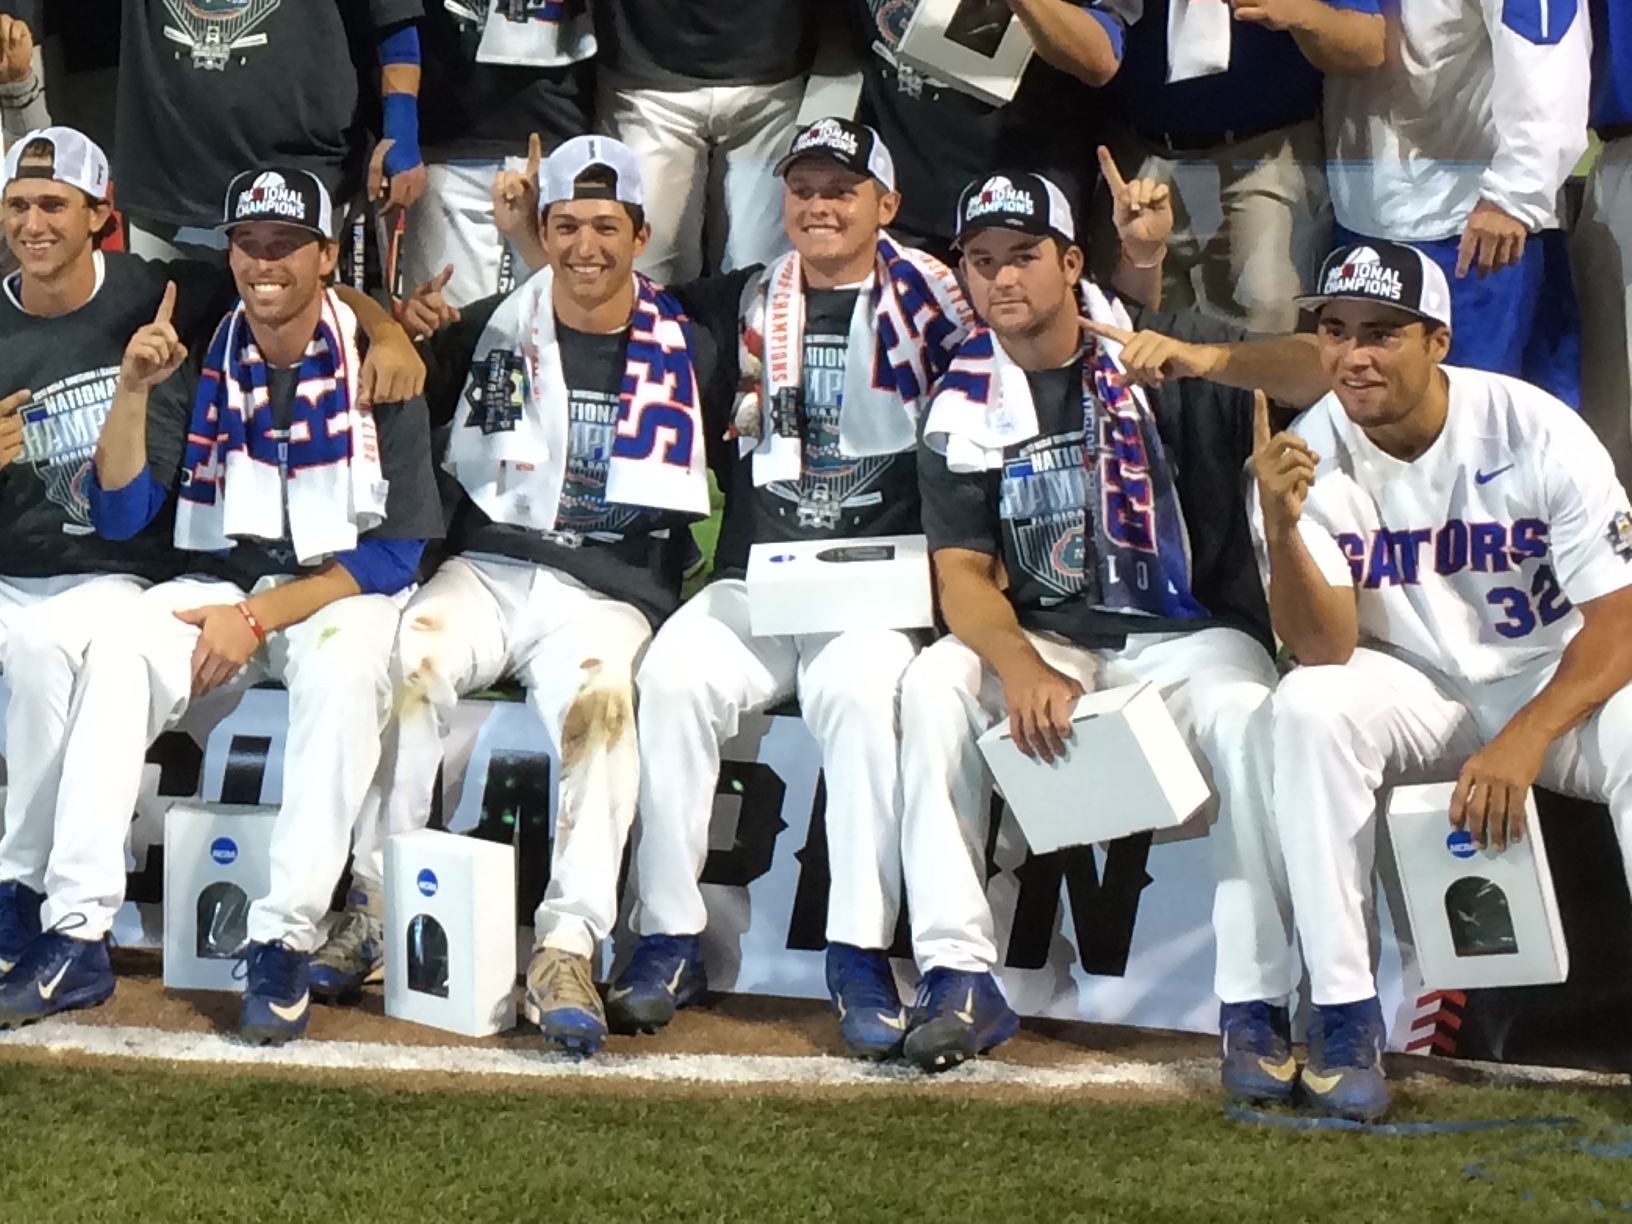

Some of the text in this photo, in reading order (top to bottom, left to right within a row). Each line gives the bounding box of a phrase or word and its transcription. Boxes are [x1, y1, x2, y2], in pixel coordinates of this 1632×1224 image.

[771, 293, 790, 383] CHAMPIONS
[804, 347, 848, 368] ATION
[44, 376, 120, 416] NATIONA
[1031, 445, 1082, 472] NATIO
[1334, 517, 1549, 589] GATORS
[1486, 563, 1575, 639] 32
